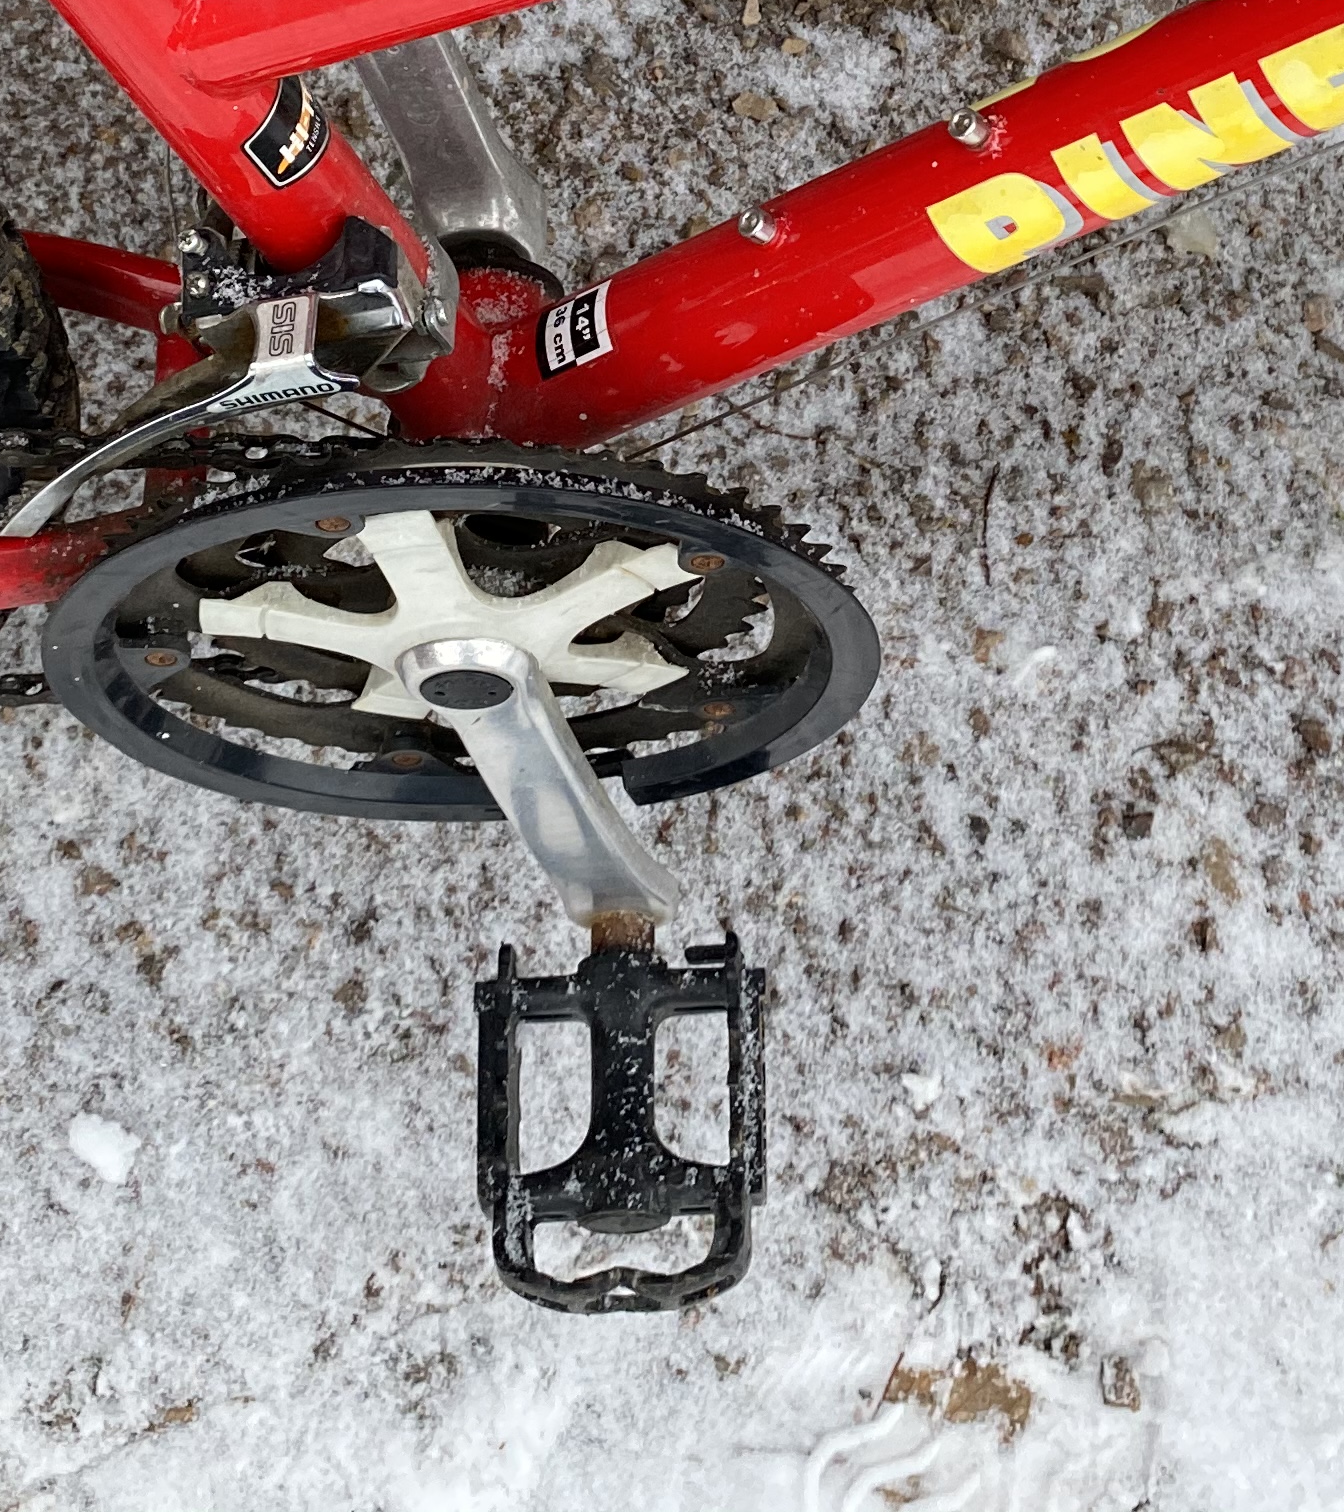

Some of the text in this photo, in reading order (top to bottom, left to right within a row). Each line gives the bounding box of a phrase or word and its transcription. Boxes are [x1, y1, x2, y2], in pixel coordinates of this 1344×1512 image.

[268, 301, 297, 357] SIS
[552, 332, 567, 365] cm
[219, 382, 336, 410] SHIMANO
